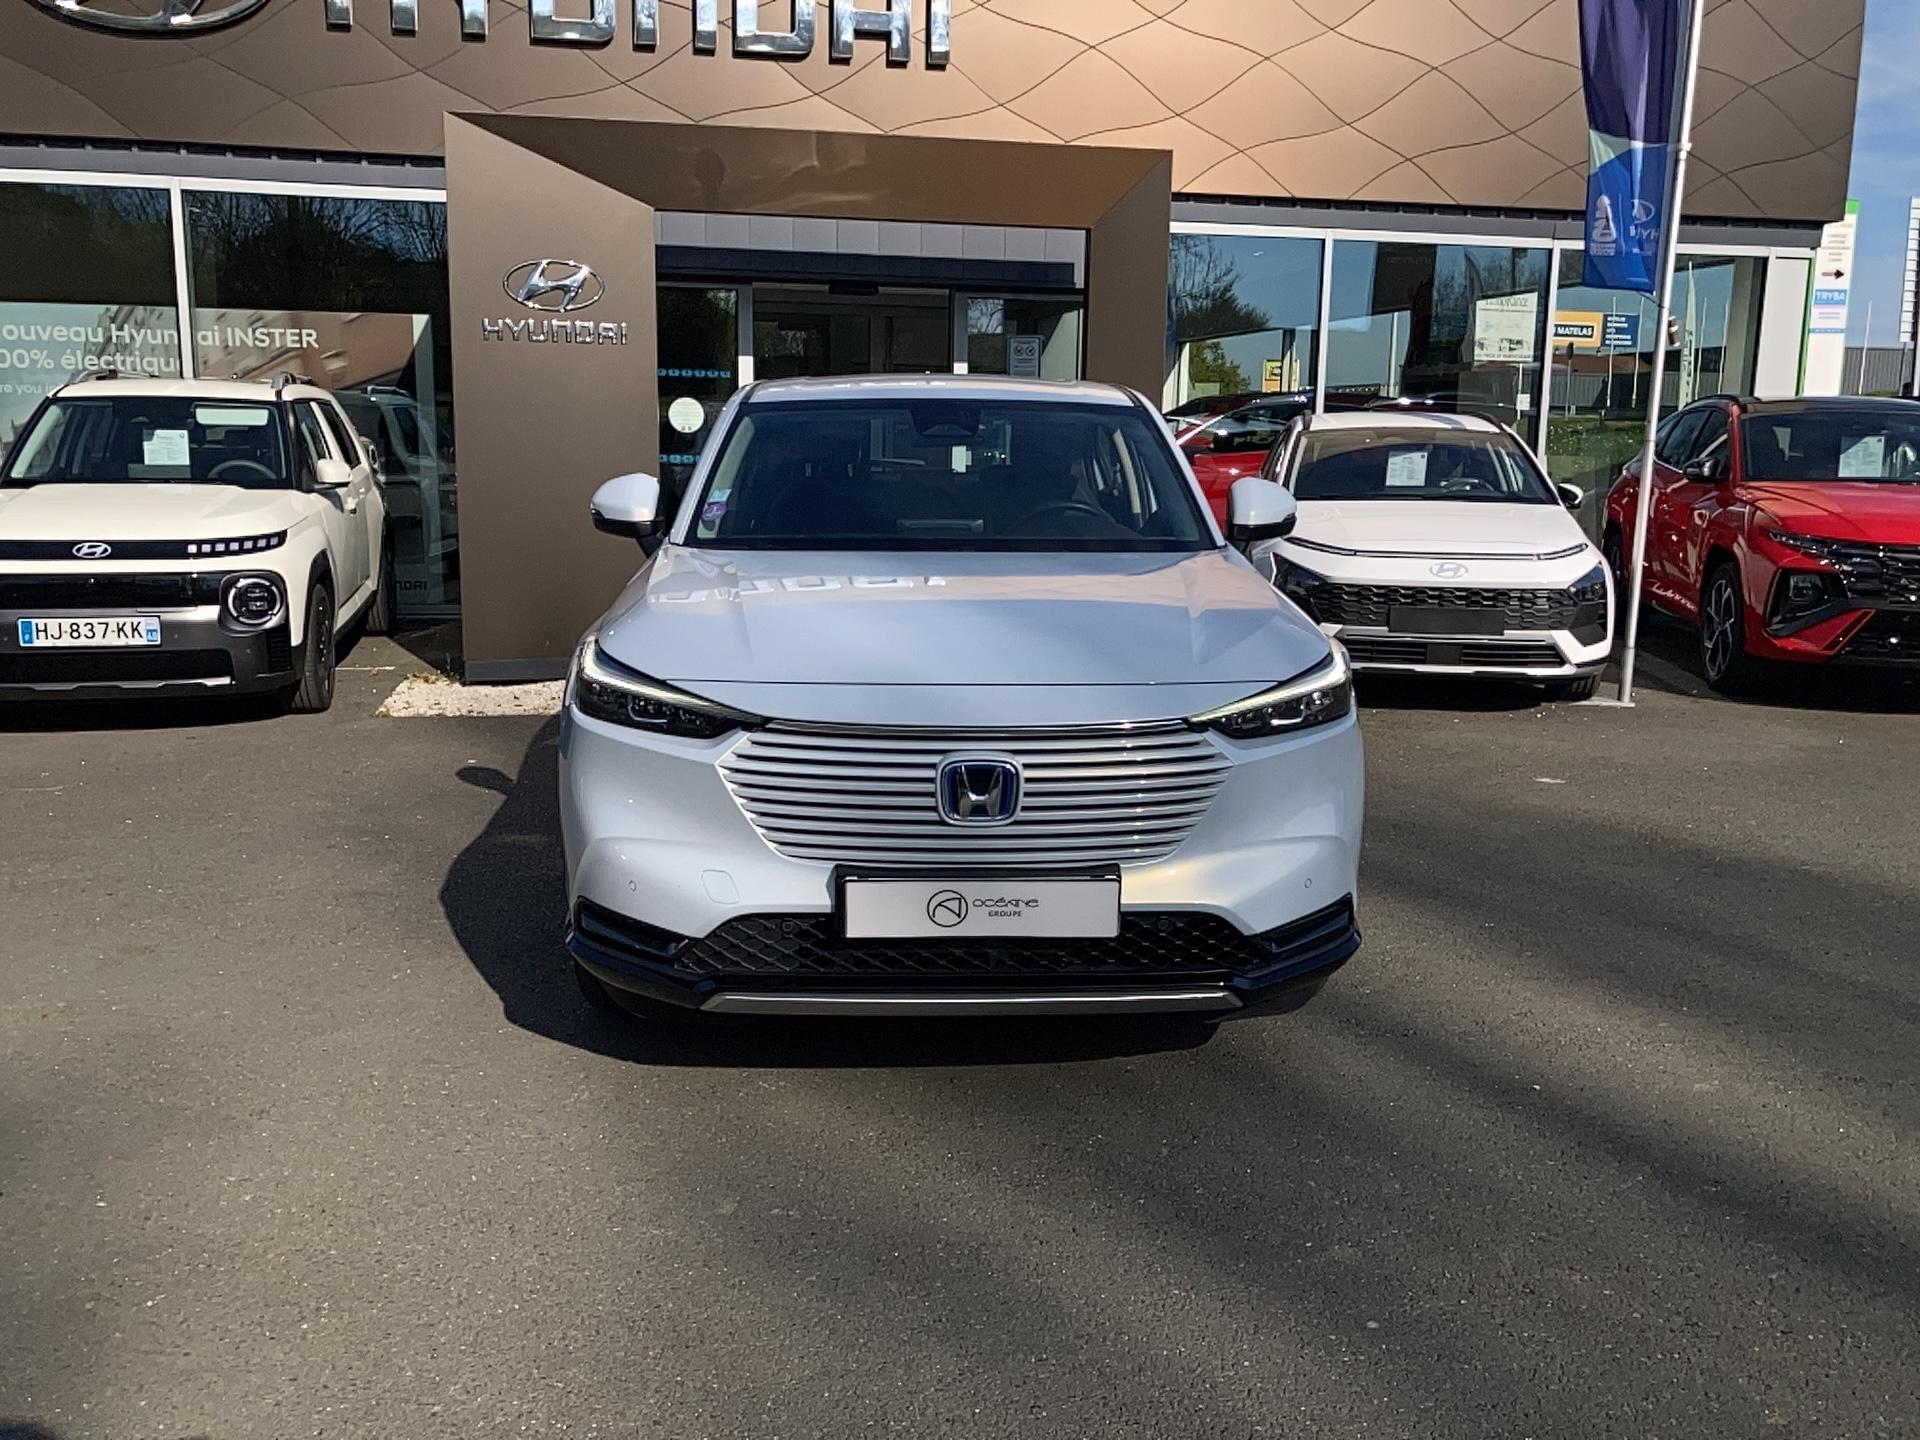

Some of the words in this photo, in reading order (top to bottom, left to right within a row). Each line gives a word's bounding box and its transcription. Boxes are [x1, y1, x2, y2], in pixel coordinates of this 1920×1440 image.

[0, 323, 103, 343] ouveau
[110, 323, 220, 348] Hyunai
[227, 327, 319, 348] INSTER
[482, 317, 627, 345] HYUNDAI
[1556, 326, 1592, 336] MATELAS
[0, 349, 54, 370] 00%
[60, 349, 180, 376] électriqu
[35, 620, 143, 641] HJ-837-KK
[988, 910, 1023, 918] GROUPE
